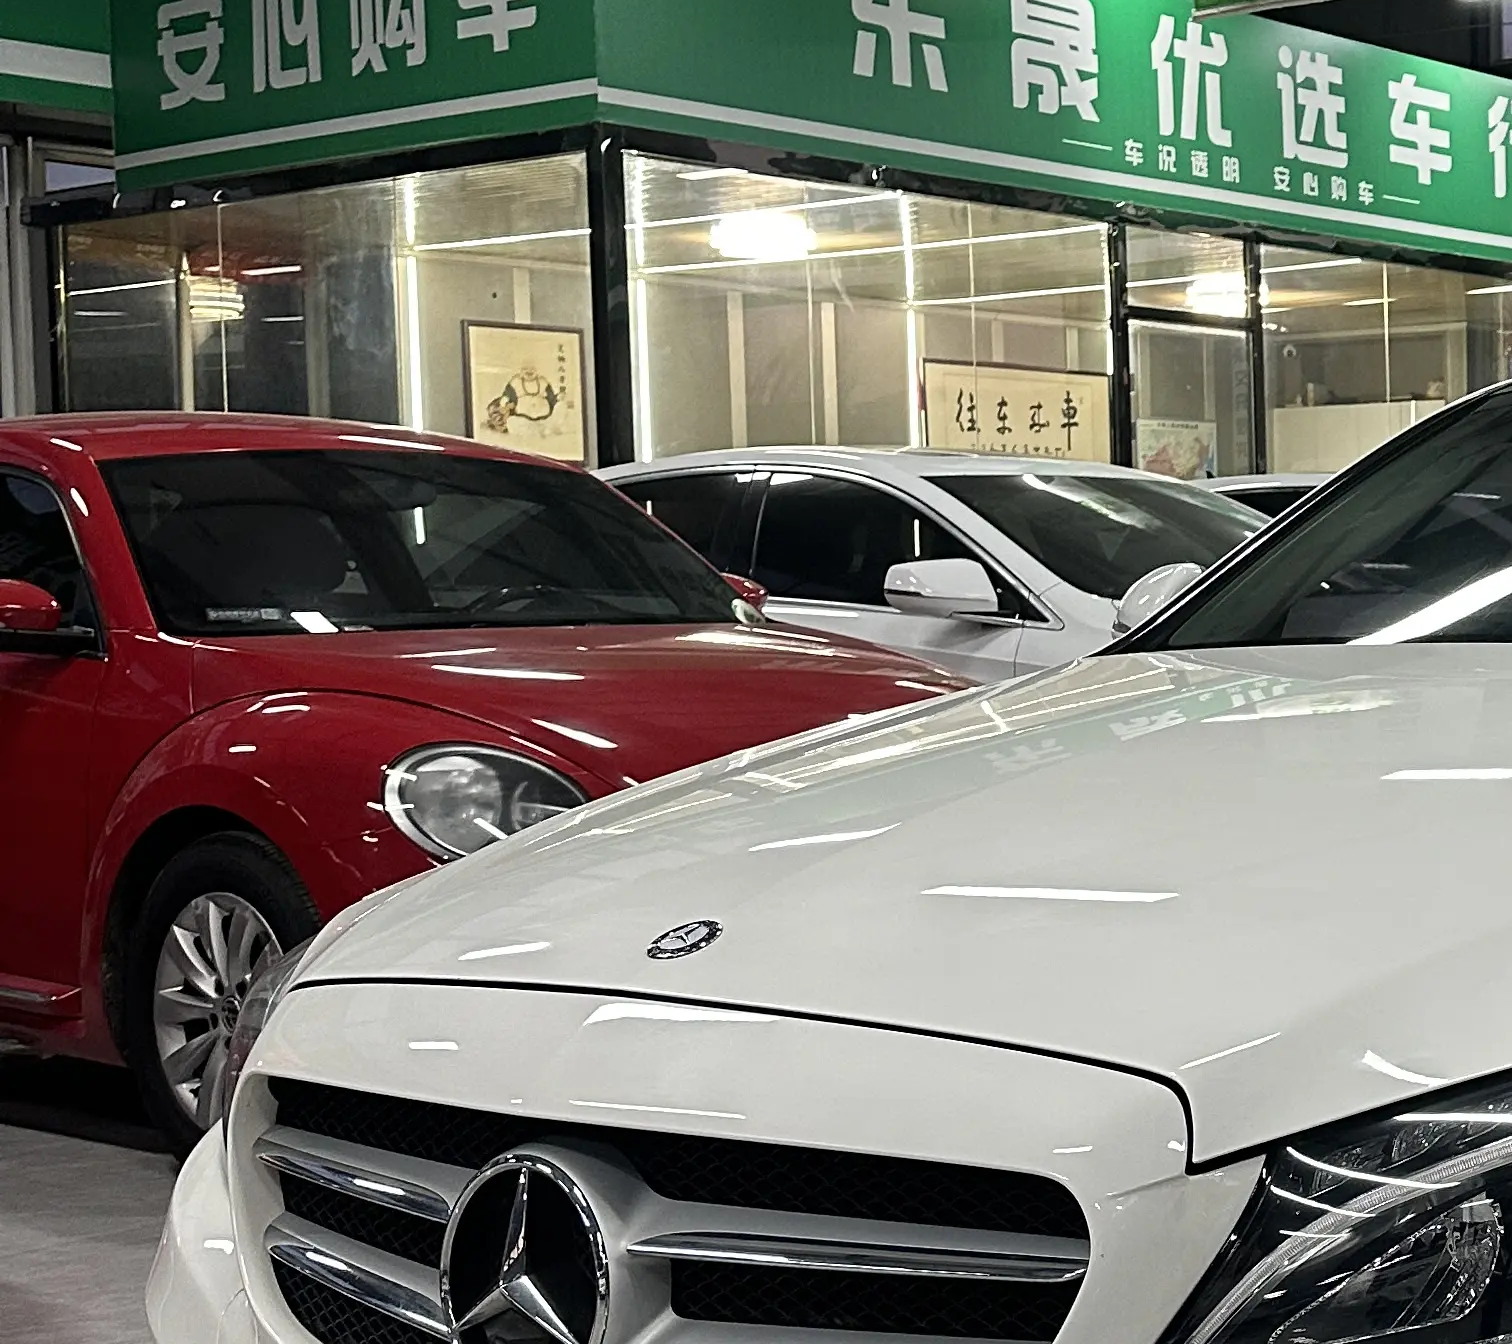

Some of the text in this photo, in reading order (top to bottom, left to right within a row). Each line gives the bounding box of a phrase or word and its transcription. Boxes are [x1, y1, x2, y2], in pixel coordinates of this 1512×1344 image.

[1124, 138, 1375, 206] 车况透明 安心购车
